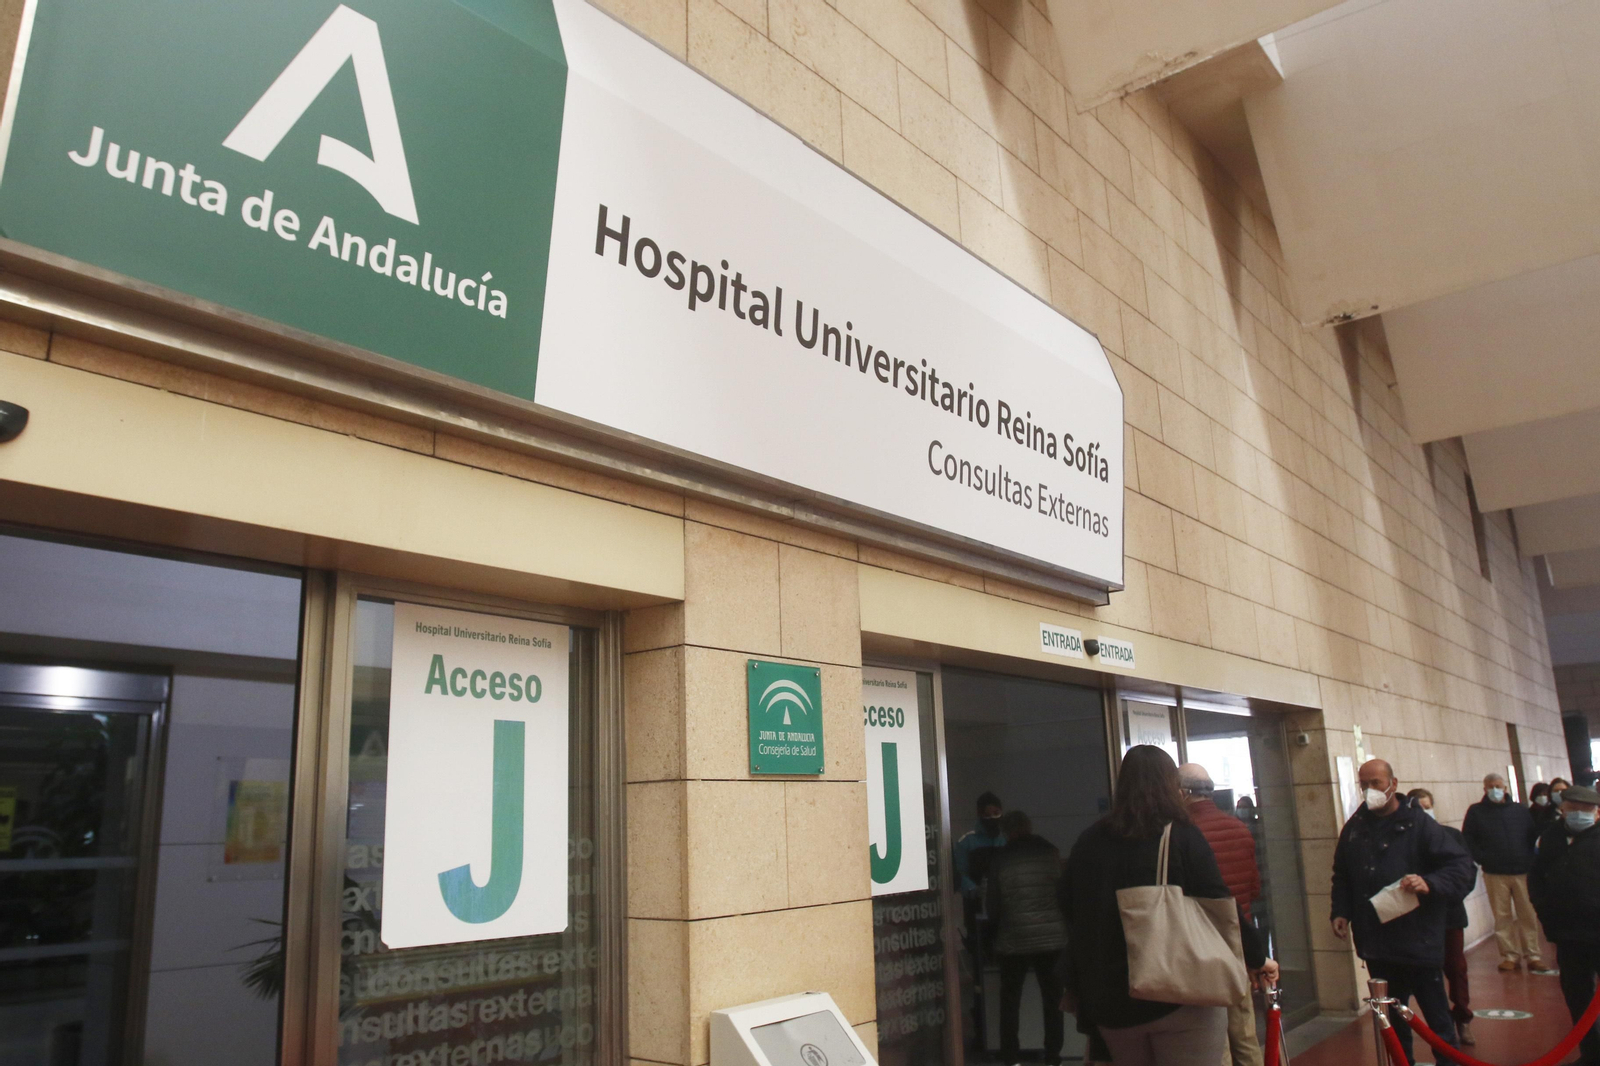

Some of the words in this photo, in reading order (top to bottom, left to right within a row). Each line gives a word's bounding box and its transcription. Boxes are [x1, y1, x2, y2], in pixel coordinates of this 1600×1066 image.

[68, 126, 227, 215] Junta
[242, 194, 300, 240] de
[308, 216, 507, 318] Andalucía
[595, 204, 782, 336] Hospital
[795, 299, 989, 427] Universitario
[998, 400, 1057, 459] Reina
[1063, 434, 1109, 484] Sofía
[928, 440, 1032, 509] Consultas
[1038, 483, 1109, 537] Externas
[415, 621, 452, 637] Hospital
[453, 627, 507, 643] Universitario
[508, 633, 531, 646] Reina
[1042, 630, 1082, 652] ENTRADA
[1100, 643, 1134, 662] ENTRADA
[424, 654, 543, 703] Acceso
[759, 731, 777, 740] JUNTA
[778, 731, 786, 741] DE
[791, 746, 800, 755] de
[800, 745, 817, 756] Salud
[437, 720, 525, 924] J
